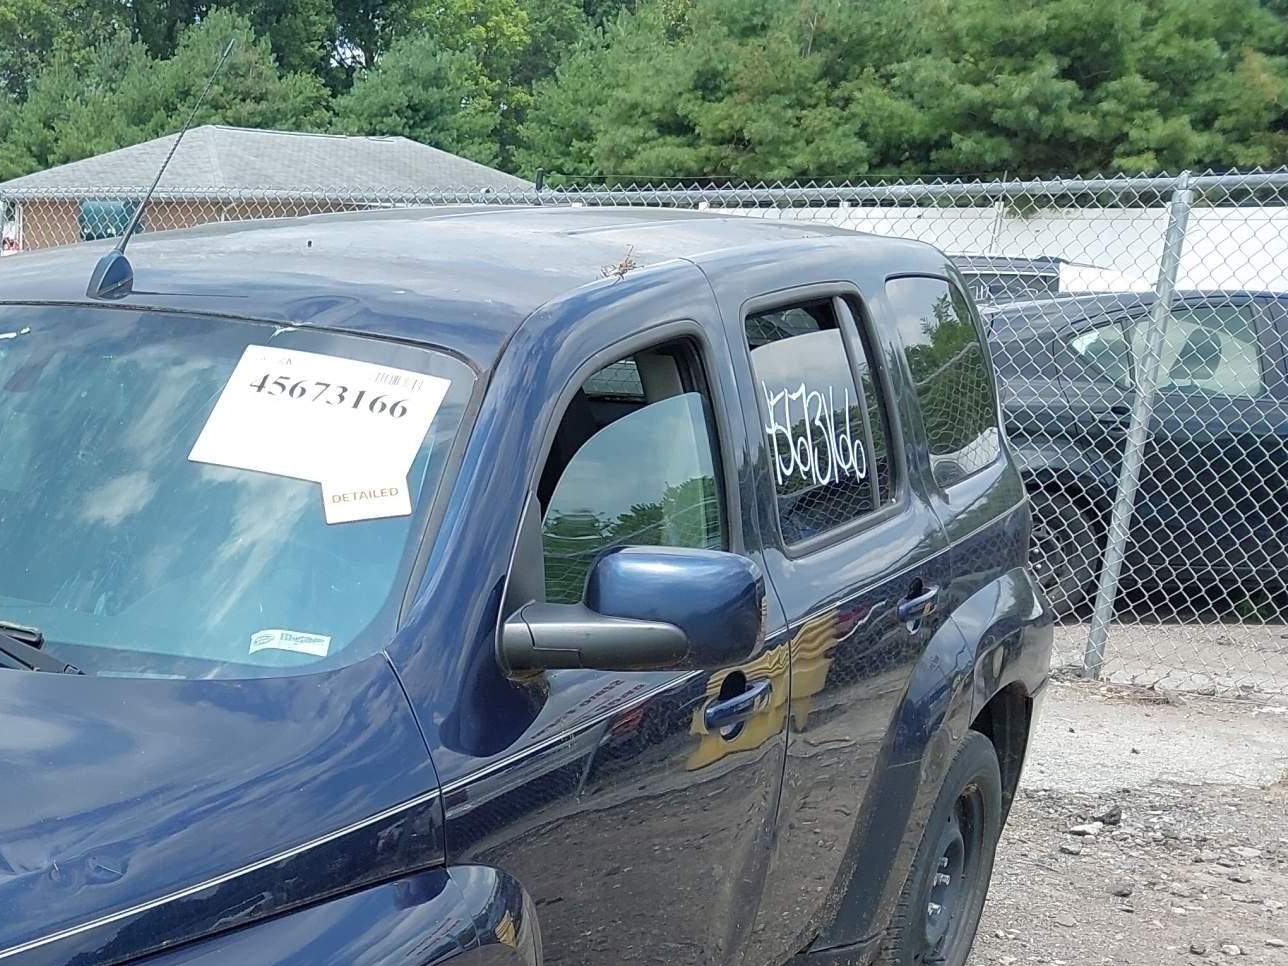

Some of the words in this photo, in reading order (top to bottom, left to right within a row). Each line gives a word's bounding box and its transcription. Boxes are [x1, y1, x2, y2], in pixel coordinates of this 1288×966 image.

[248, 372, 409, 419] 45673166
[761, 380, 867, 486] 45673166
[330, 486, 399, 504] DETAILED
